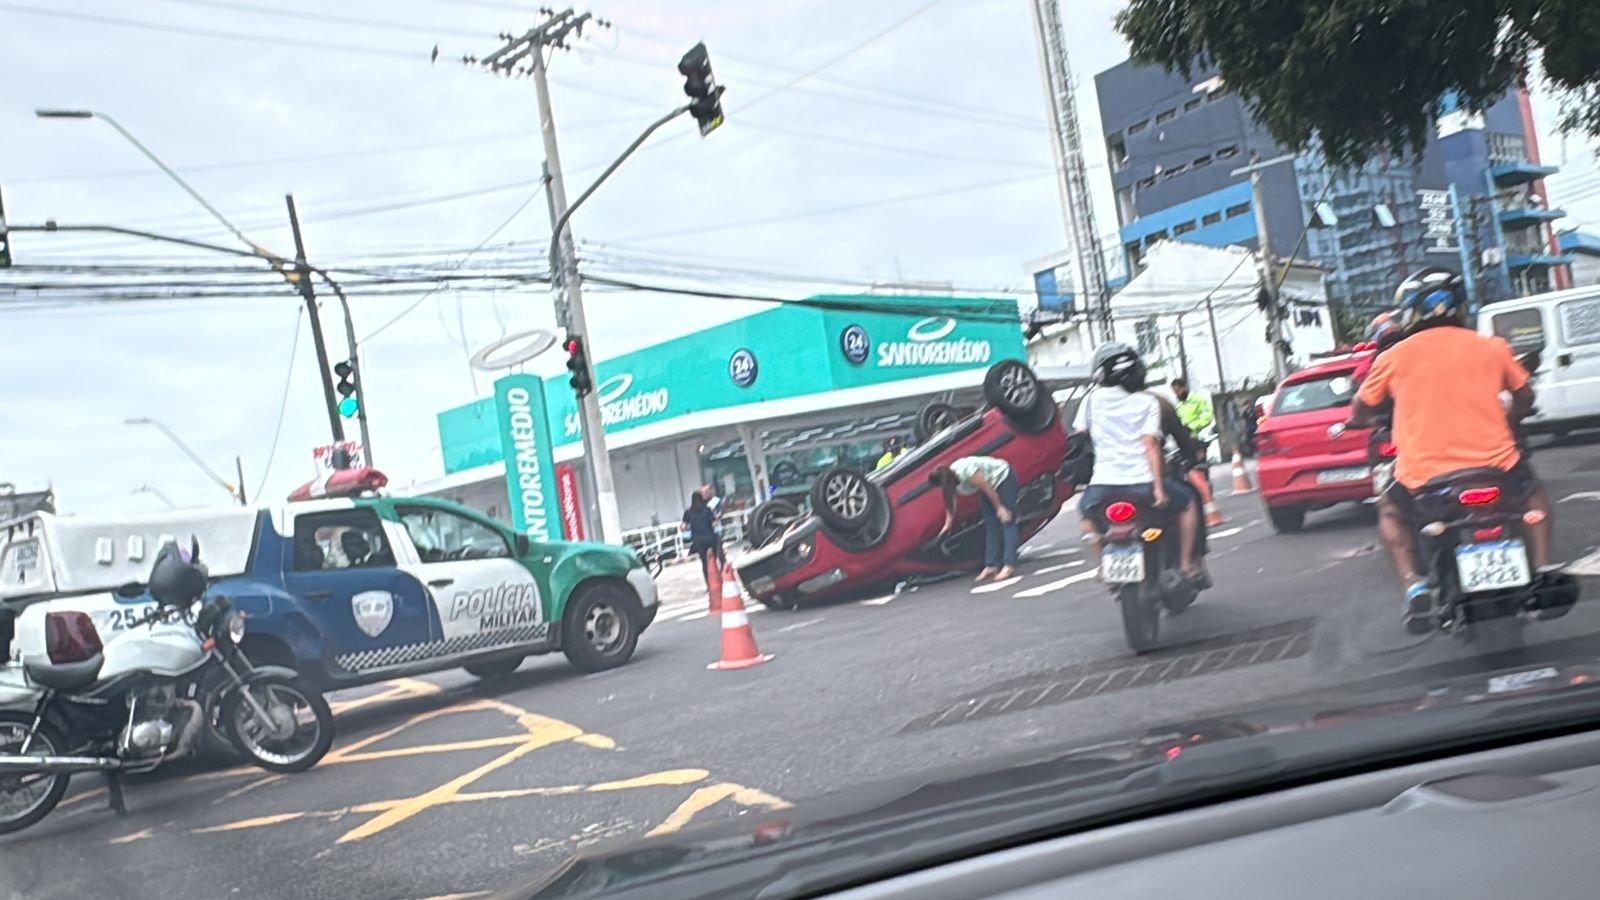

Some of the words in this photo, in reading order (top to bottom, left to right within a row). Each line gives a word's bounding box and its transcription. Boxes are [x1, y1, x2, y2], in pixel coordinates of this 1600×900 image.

[848, 334, 864, 350] 24
[877, 337, 991, 367] SANTOREMÉDIO
[449, 581, 537, 622] POLÍCIA
[480, 608, 537, 630] MILITAR
